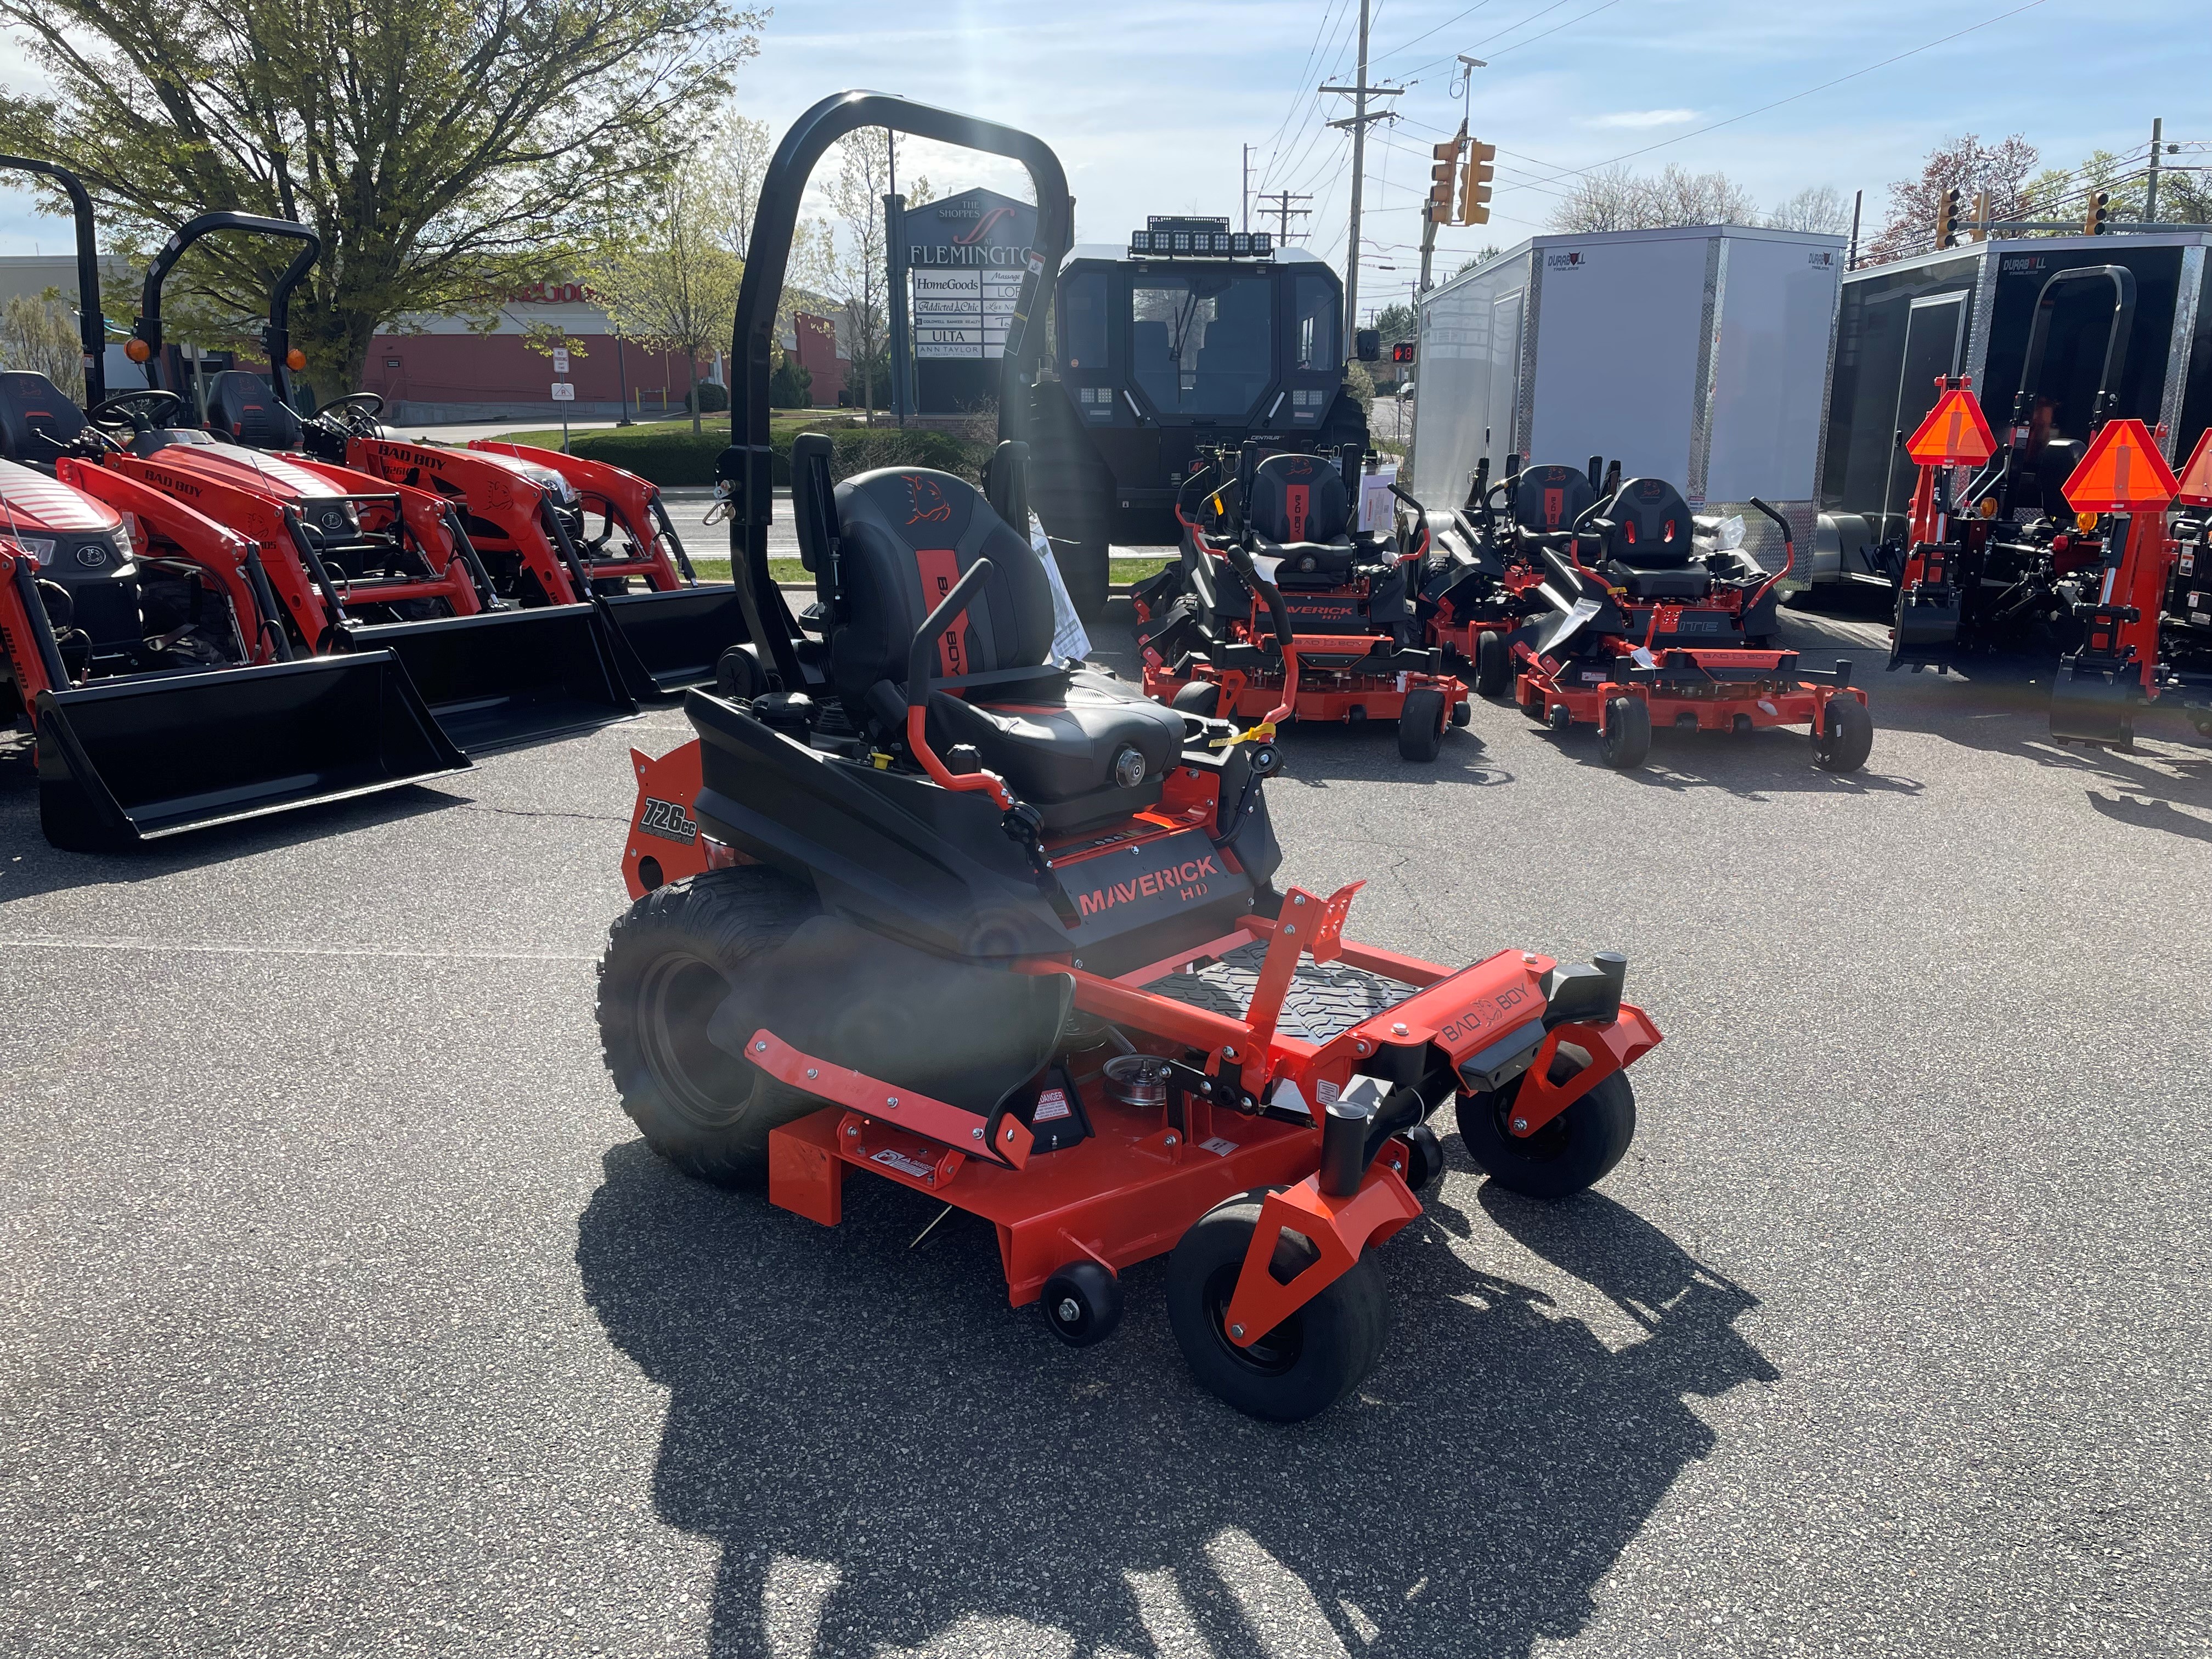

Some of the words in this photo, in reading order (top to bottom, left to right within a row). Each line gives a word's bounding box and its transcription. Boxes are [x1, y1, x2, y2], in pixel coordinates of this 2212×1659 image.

[962, 201, 979, 209] THE
[939, 210, 980, 218] SHOPPES
[910, 246, 1031, 264] FLEMINGTO
[991, 272, 1020, 281] Massage
[917, 278, 978, 290] HomeGoods
[998, 286, 1021, 297] LOF
[918, 301, 954, 312] Addicted
[961, 302, 979, 312] Chic
[933, 331, 965, 342] ULTA
[378, 444, 410, 462] BAD
[414, 453, 447, 471] BOY
[145, 470, 172, 487] BAD
[176, 480, 203, 498] BOY
[1286, 606, 1353, 615] AVERICK
[946, 631, 960, 675] BOY
[639, 825, 681, 843] MAVERICK
[681, 836, 695, 845] HD
[1079, 855, 1219, 916] MAVERICK
[1180, 883, 1209, 901] HD
[1442, 1013, 1482, 1042] BAD
[1495, 983, 1529, 1011] BOY
[1040, 1092, 1064, 1104] DANGER
